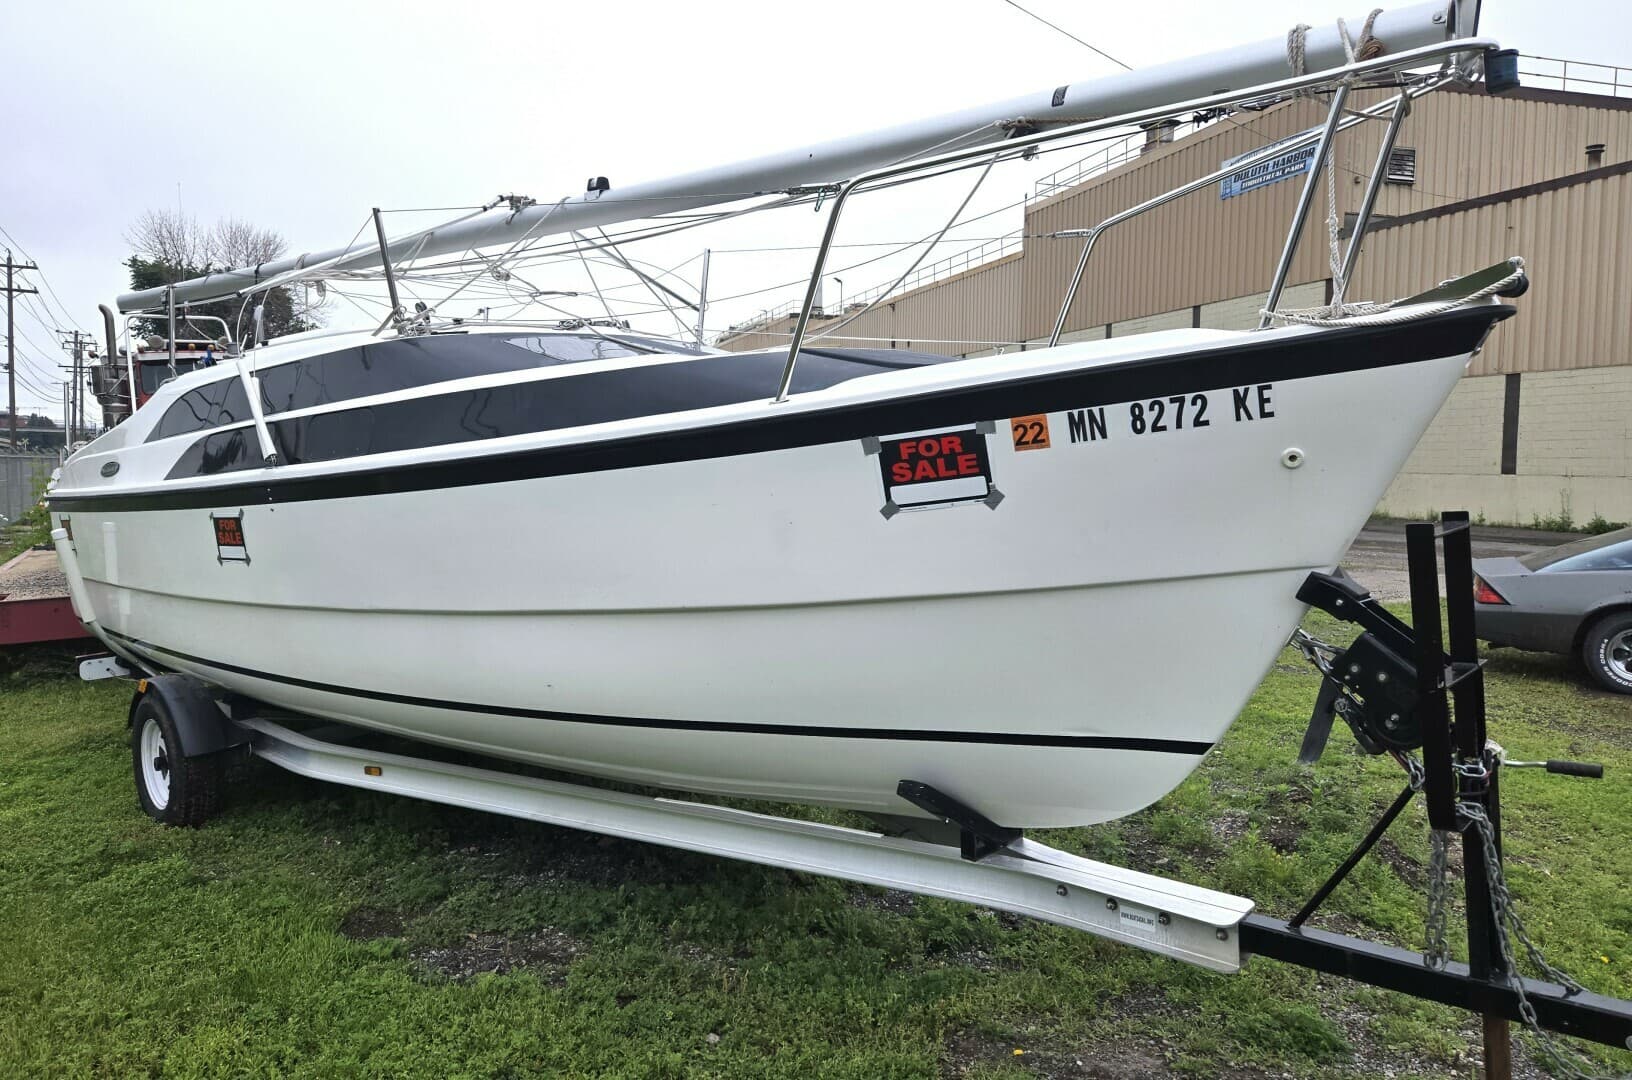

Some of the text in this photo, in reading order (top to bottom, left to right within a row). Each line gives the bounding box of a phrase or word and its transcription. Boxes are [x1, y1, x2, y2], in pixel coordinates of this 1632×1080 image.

[1272, 147, 1315, 171] HARBOR
[1285, 162, 1305, 173] PARK
[1067, 384, 1275, 443] MN 8272 KE
[1013, 421, 1046, 447] 22
[899, 436, 963, 460] FOR
[891, 453, 980, 483] SALE
[219, 520, 236, 530] FOR
[218, 532, 243, 545] SALE
